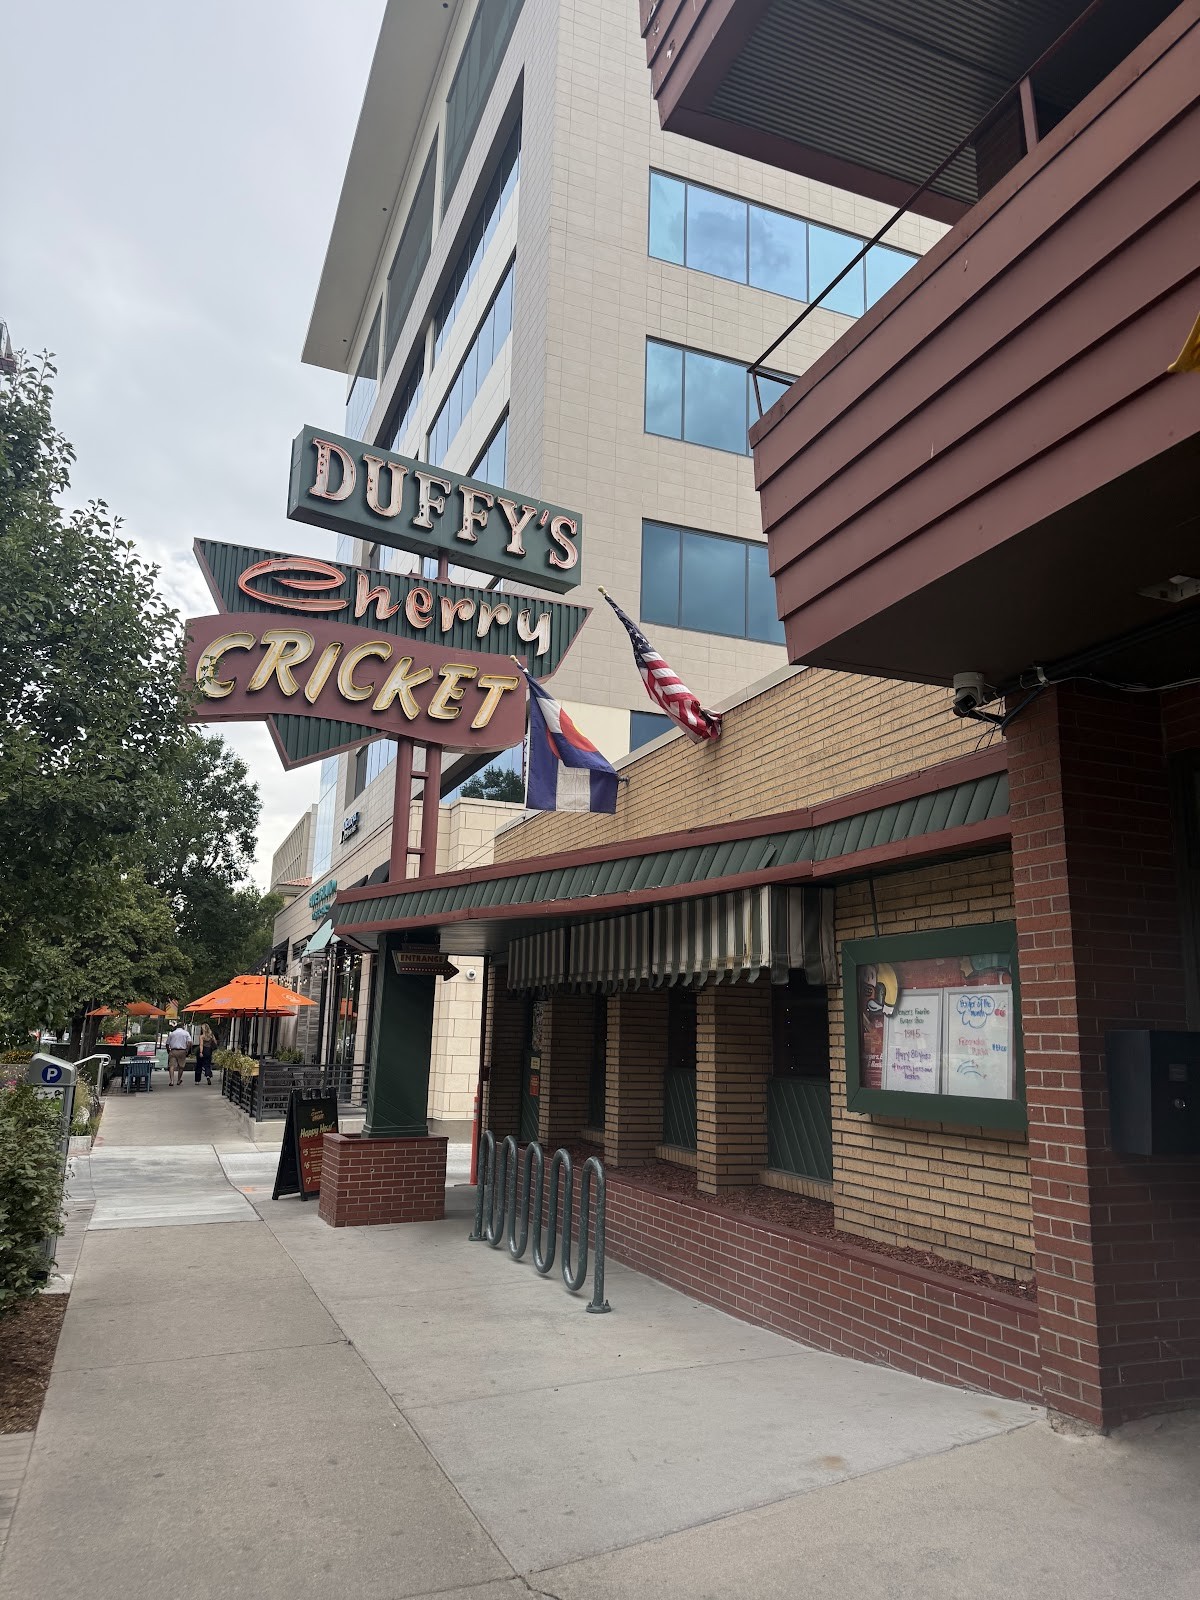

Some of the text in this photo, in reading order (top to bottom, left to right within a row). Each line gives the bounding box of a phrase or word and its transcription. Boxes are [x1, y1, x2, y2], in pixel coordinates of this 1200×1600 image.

[309, 437, 579, 570] DUFFY'S
[238, 557, 554, 657] Cherry
[195, 629, 521, 730] CRICKET
[400, 954, 445, 963] ENTRANCE
[47, 1068, 58, 1080] P
[301, 1122, 335, 1138] Happy Hour
